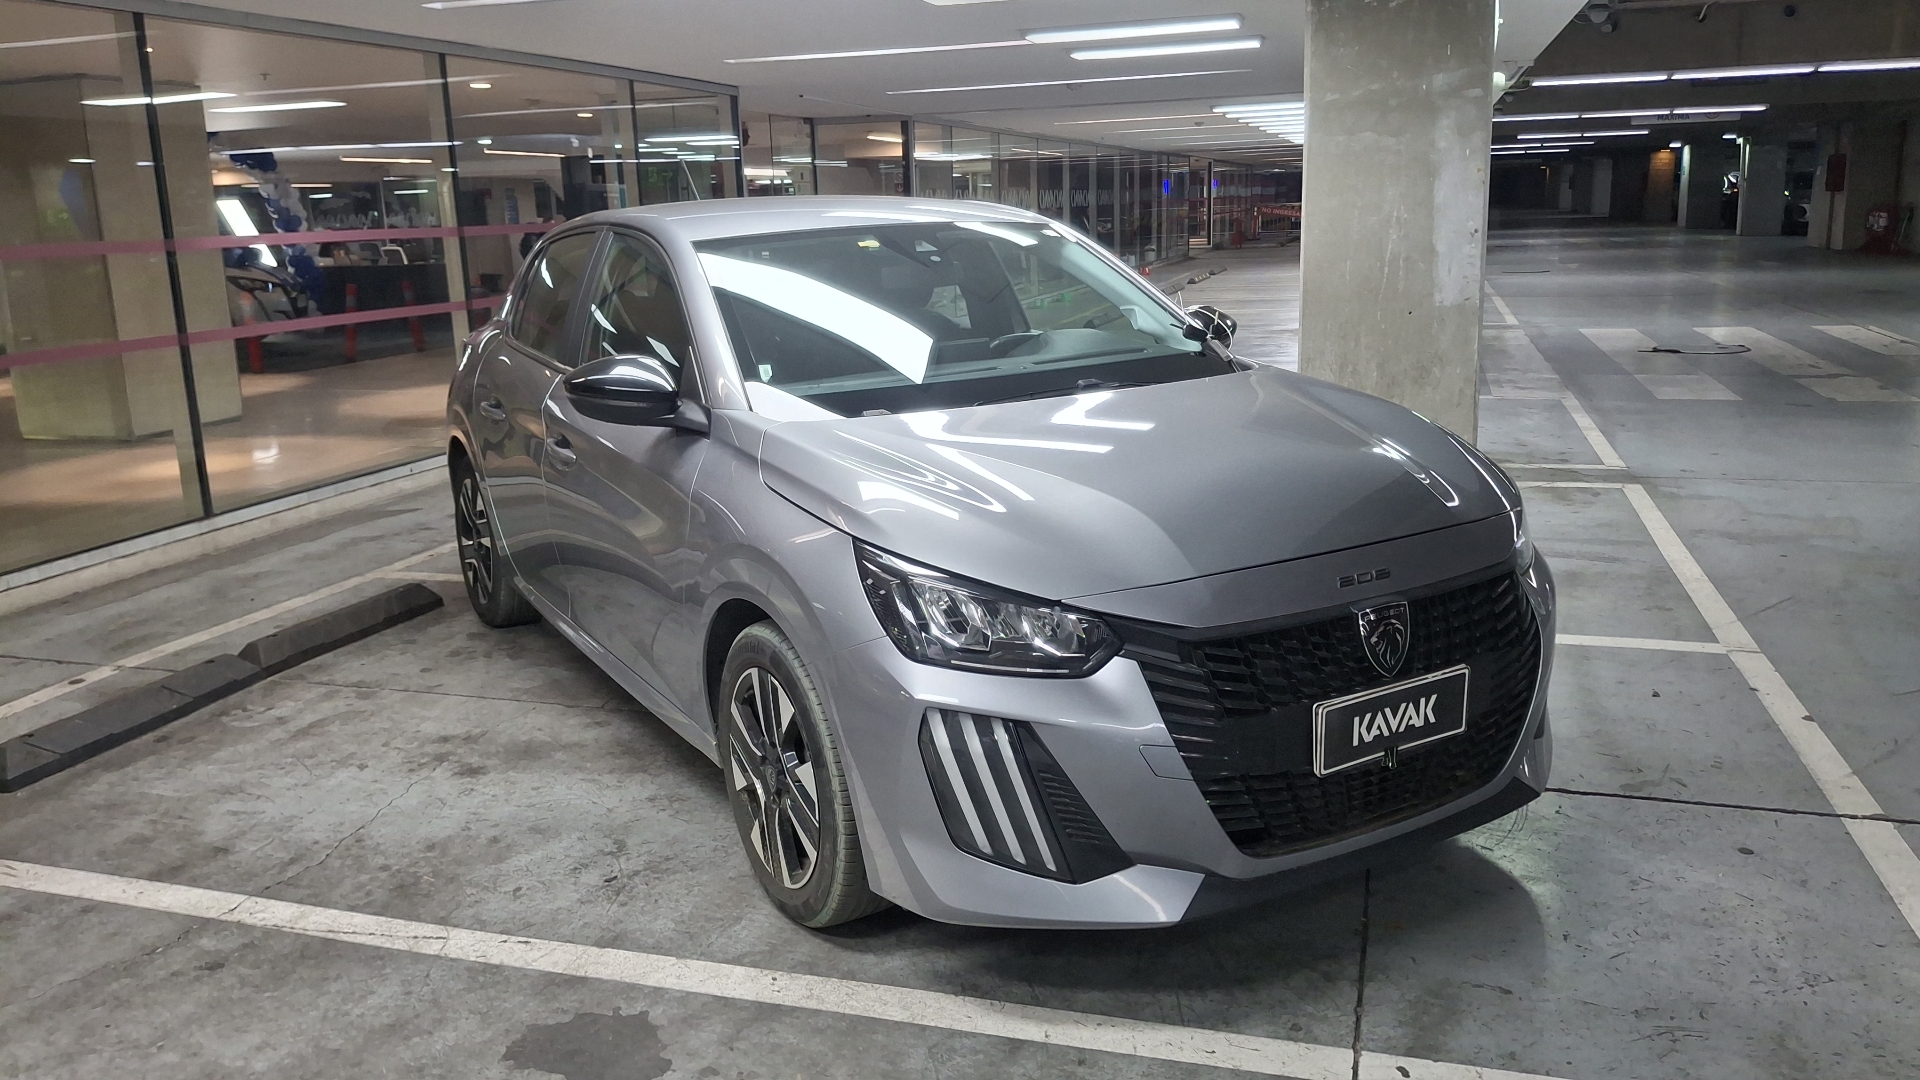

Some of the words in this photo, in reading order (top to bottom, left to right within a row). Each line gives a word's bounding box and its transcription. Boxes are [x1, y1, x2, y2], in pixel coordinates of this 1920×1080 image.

[1337, 568, 1390, 588] 208
[1364, 607, 1405, 622] PEUGEOT
[1353, 693, 1438, 747] KAVAK
